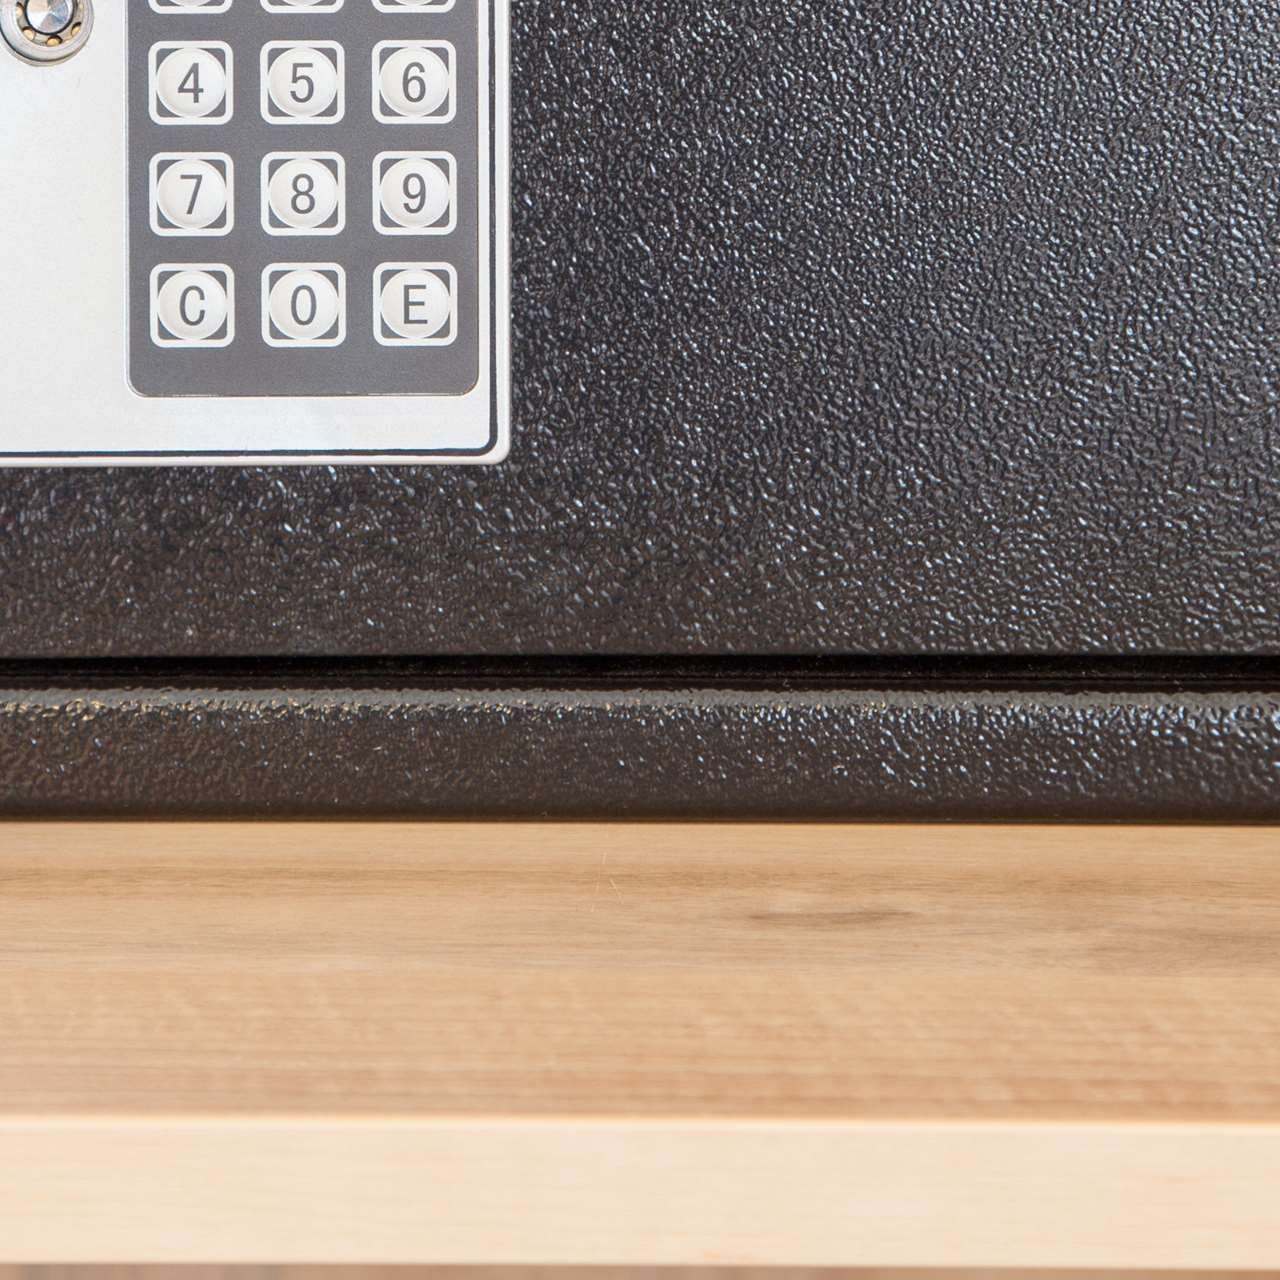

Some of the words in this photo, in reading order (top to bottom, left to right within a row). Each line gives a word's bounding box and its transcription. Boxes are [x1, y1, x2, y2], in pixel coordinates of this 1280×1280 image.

[177, 62, 205, 104] 4
[289, 62, 315, 104] 5
[401, 61, 427, 103] 6
[179, 174, 204, 215] 7
[290, 173, 316, 215] 8
[401, 172, 427, 214] 9
[178, 285, 206, 327] C
[290, 284, 318, 326] 0
[402, 284, 429, 325] E
